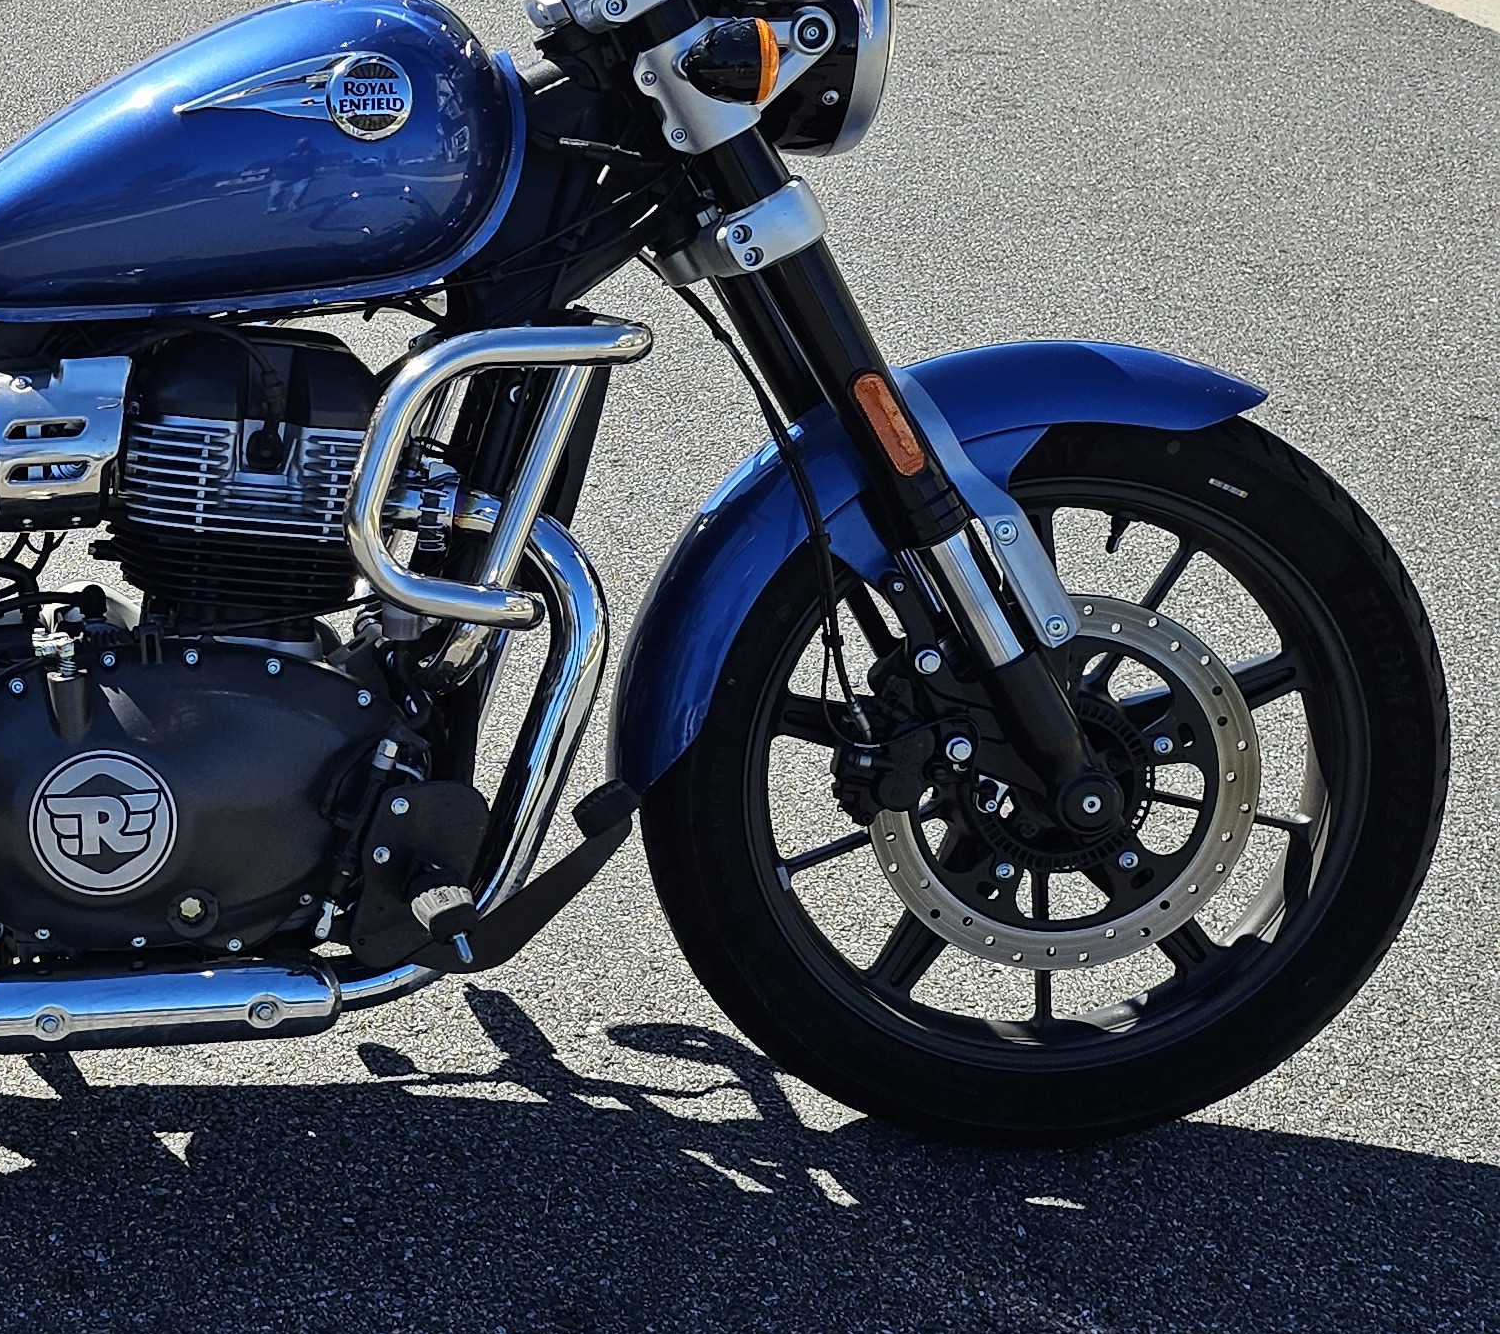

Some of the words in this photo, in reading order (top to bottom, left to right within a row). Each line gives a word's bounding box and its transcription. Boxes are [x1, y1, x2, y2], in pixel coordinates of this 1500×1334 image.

[343, 80, 398, 97] ROYAL
[339, 97, 405, 114] ENFIELD
[46, 796, 148, 856] R
